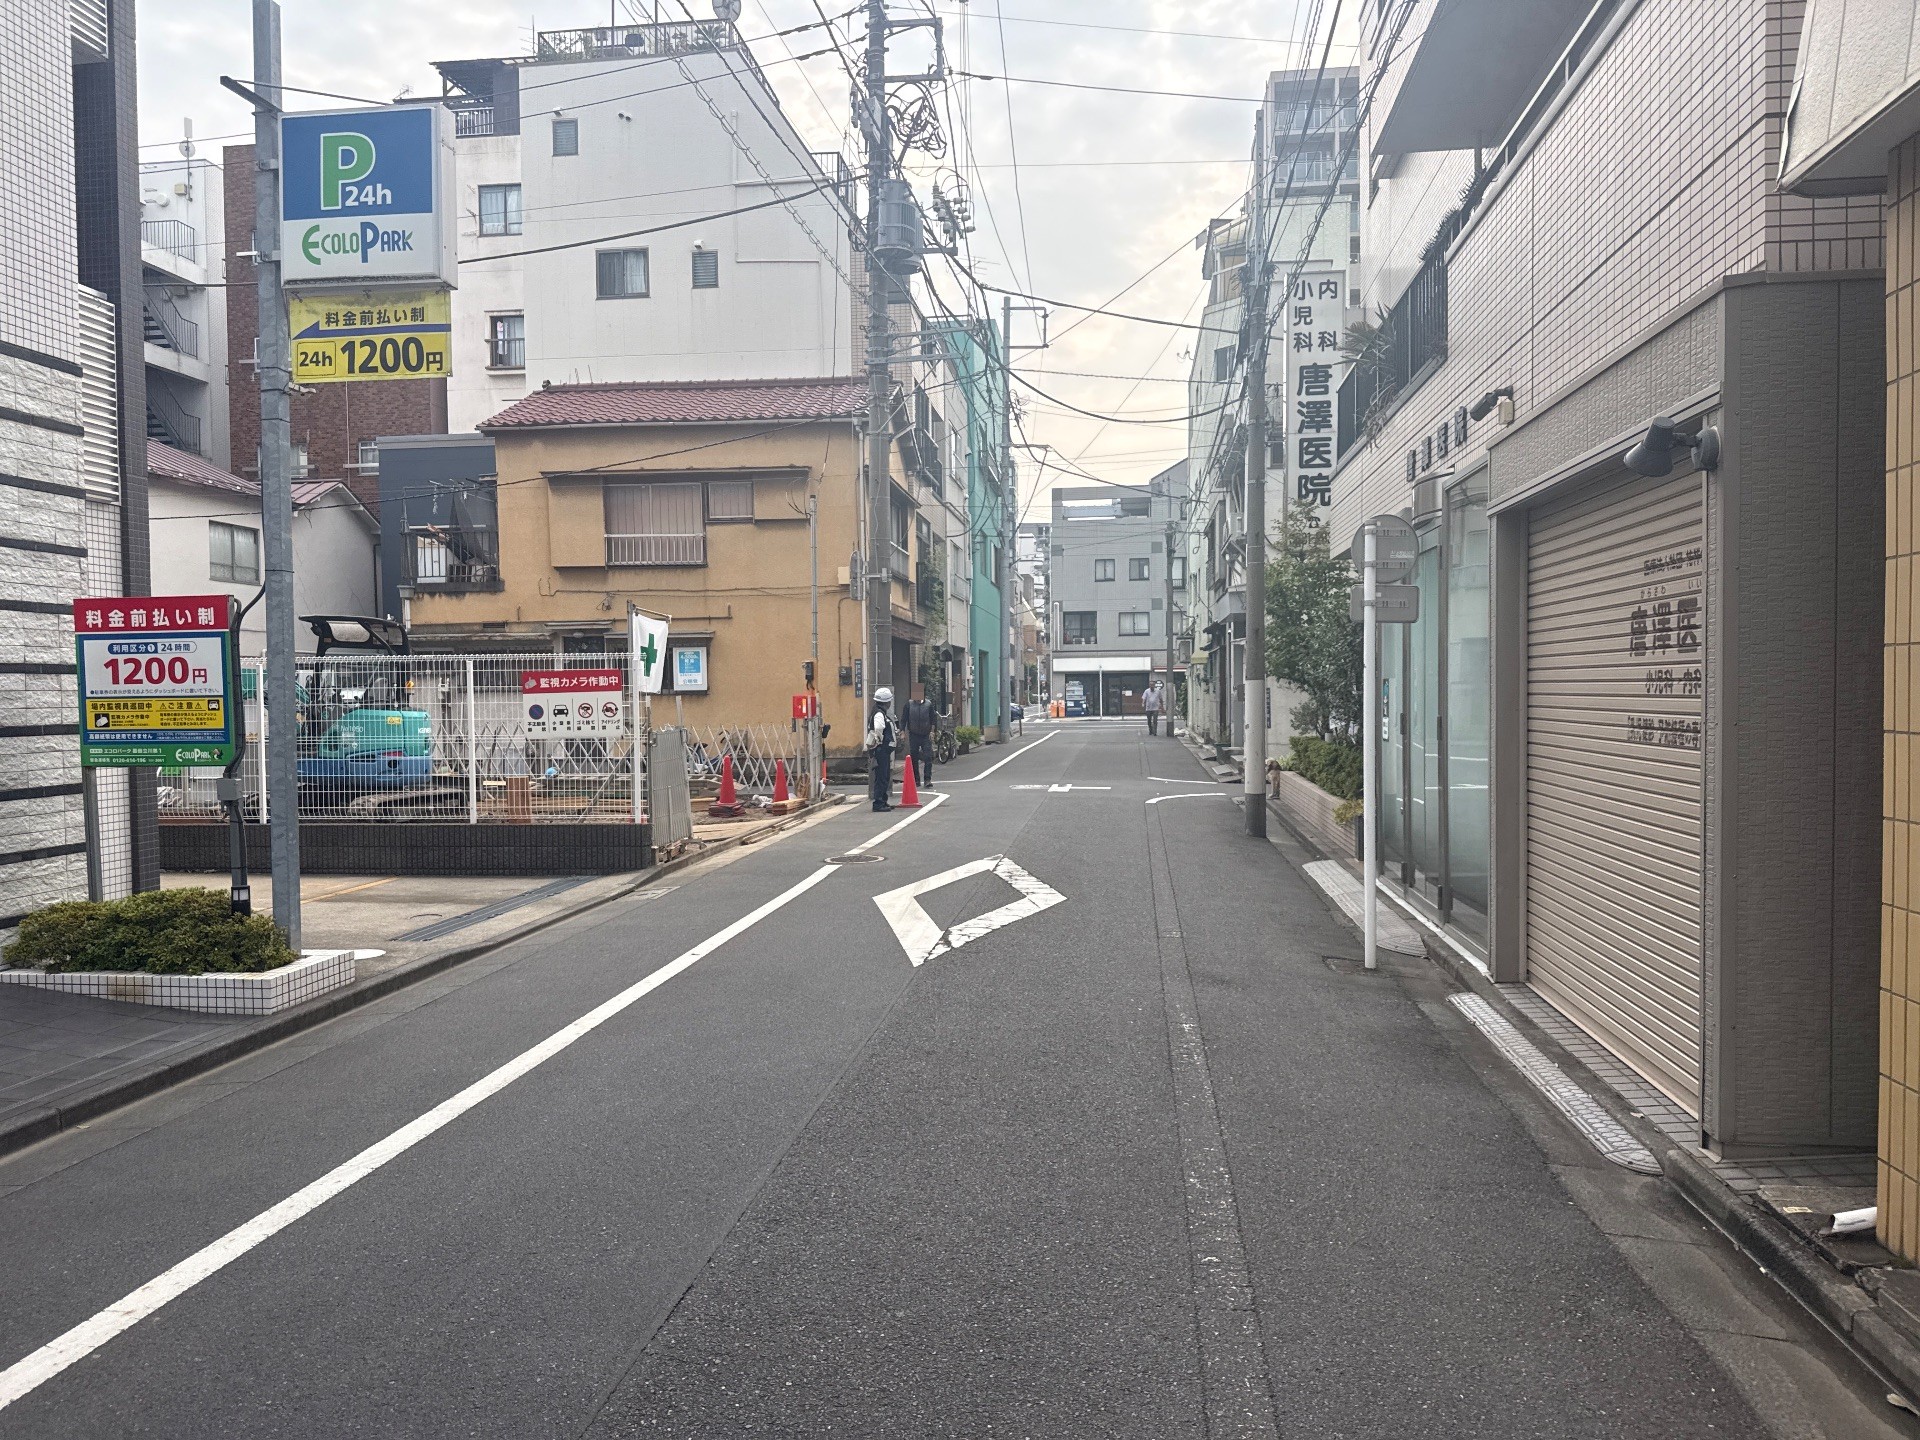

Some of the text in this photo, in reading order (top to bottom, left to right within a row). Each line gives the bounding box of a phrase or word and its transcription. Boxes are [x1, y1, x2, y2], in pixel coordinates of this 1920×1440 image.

[320, 132, 376, 210] P
[345, 184, 392, 206] 24h
[325, 307, 425, 327] 料金前払い制
[1293, 280, 1313, 353] 小児科
[299, 337, 443, 375] 24h 1200円
[1297, 362, 1333, 507] 唐澤医院
[86, 607, 215, 628] 料金前払い制
[161, 642, 191, 653] 24時間
[104, 657, 208, 685] 1200円
[540, 676, 619, 688] 監視カメラ作動中
[168, 702, 194, 710] ご注意
